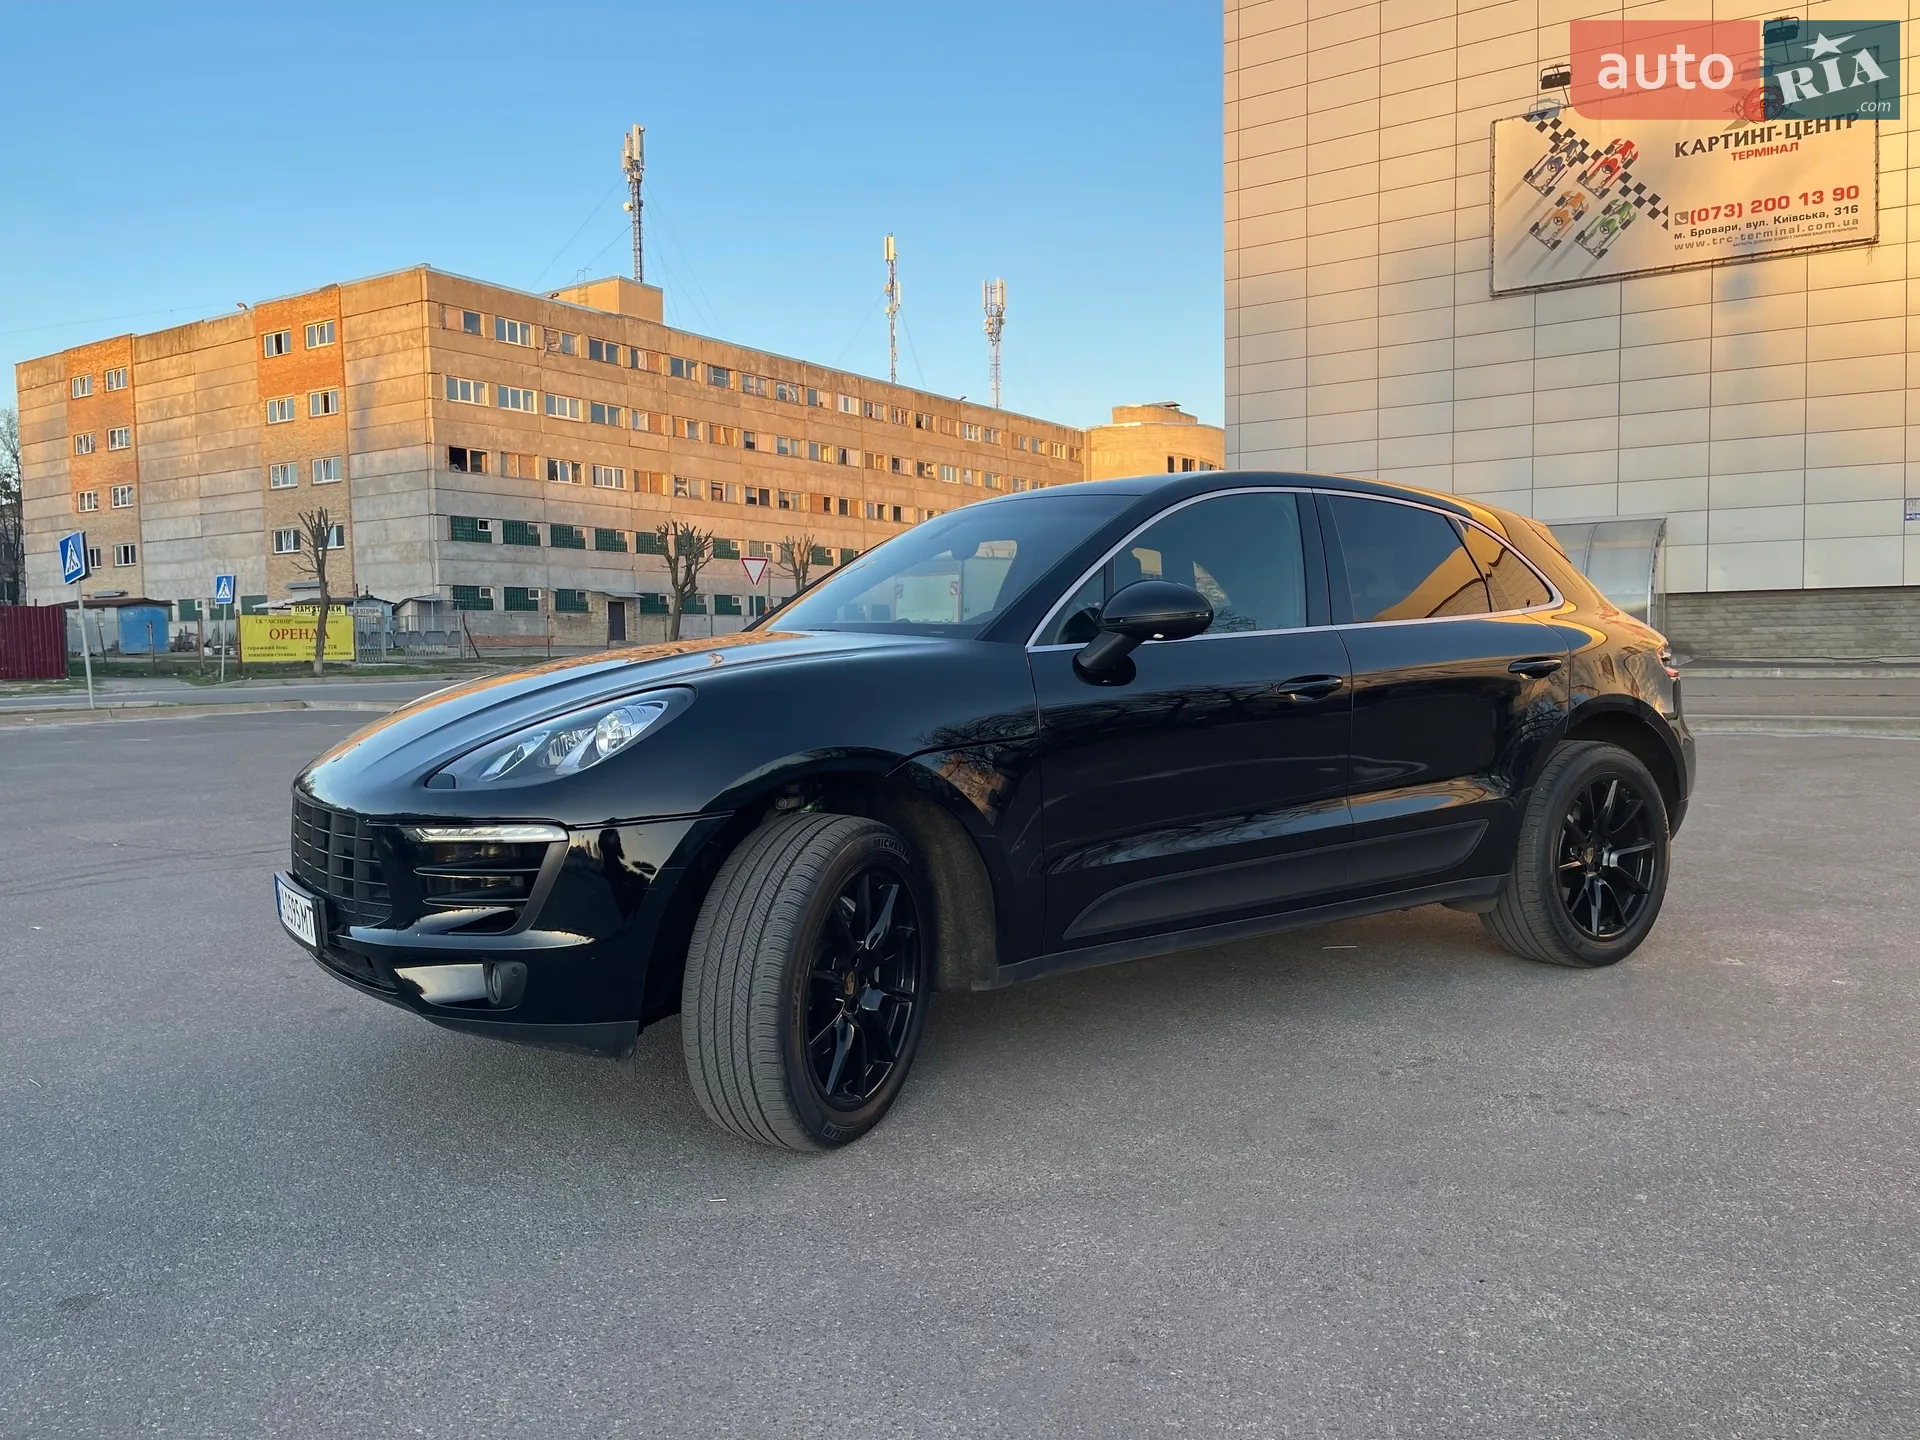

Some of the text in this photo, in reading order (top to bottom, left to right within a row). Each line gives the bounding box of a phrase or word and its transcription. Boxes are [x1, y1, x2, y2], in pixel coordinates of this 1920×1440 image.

[1675, 112, 1860, 158] КАРТИНГ-ЦЕНТР
[1731, 142, 1799, 161] ТЕРМІНАЛ
[1674, 204, 1859, 240] м. Бровари, вул. Київська, 316
[1690, 185, 1860, 225] (073) 200 13 90
[1674, 218, 1859, 251] www.trc-terminal.com.ua
[295, 605, 342, 613] ПАМ'ЯТКИ
